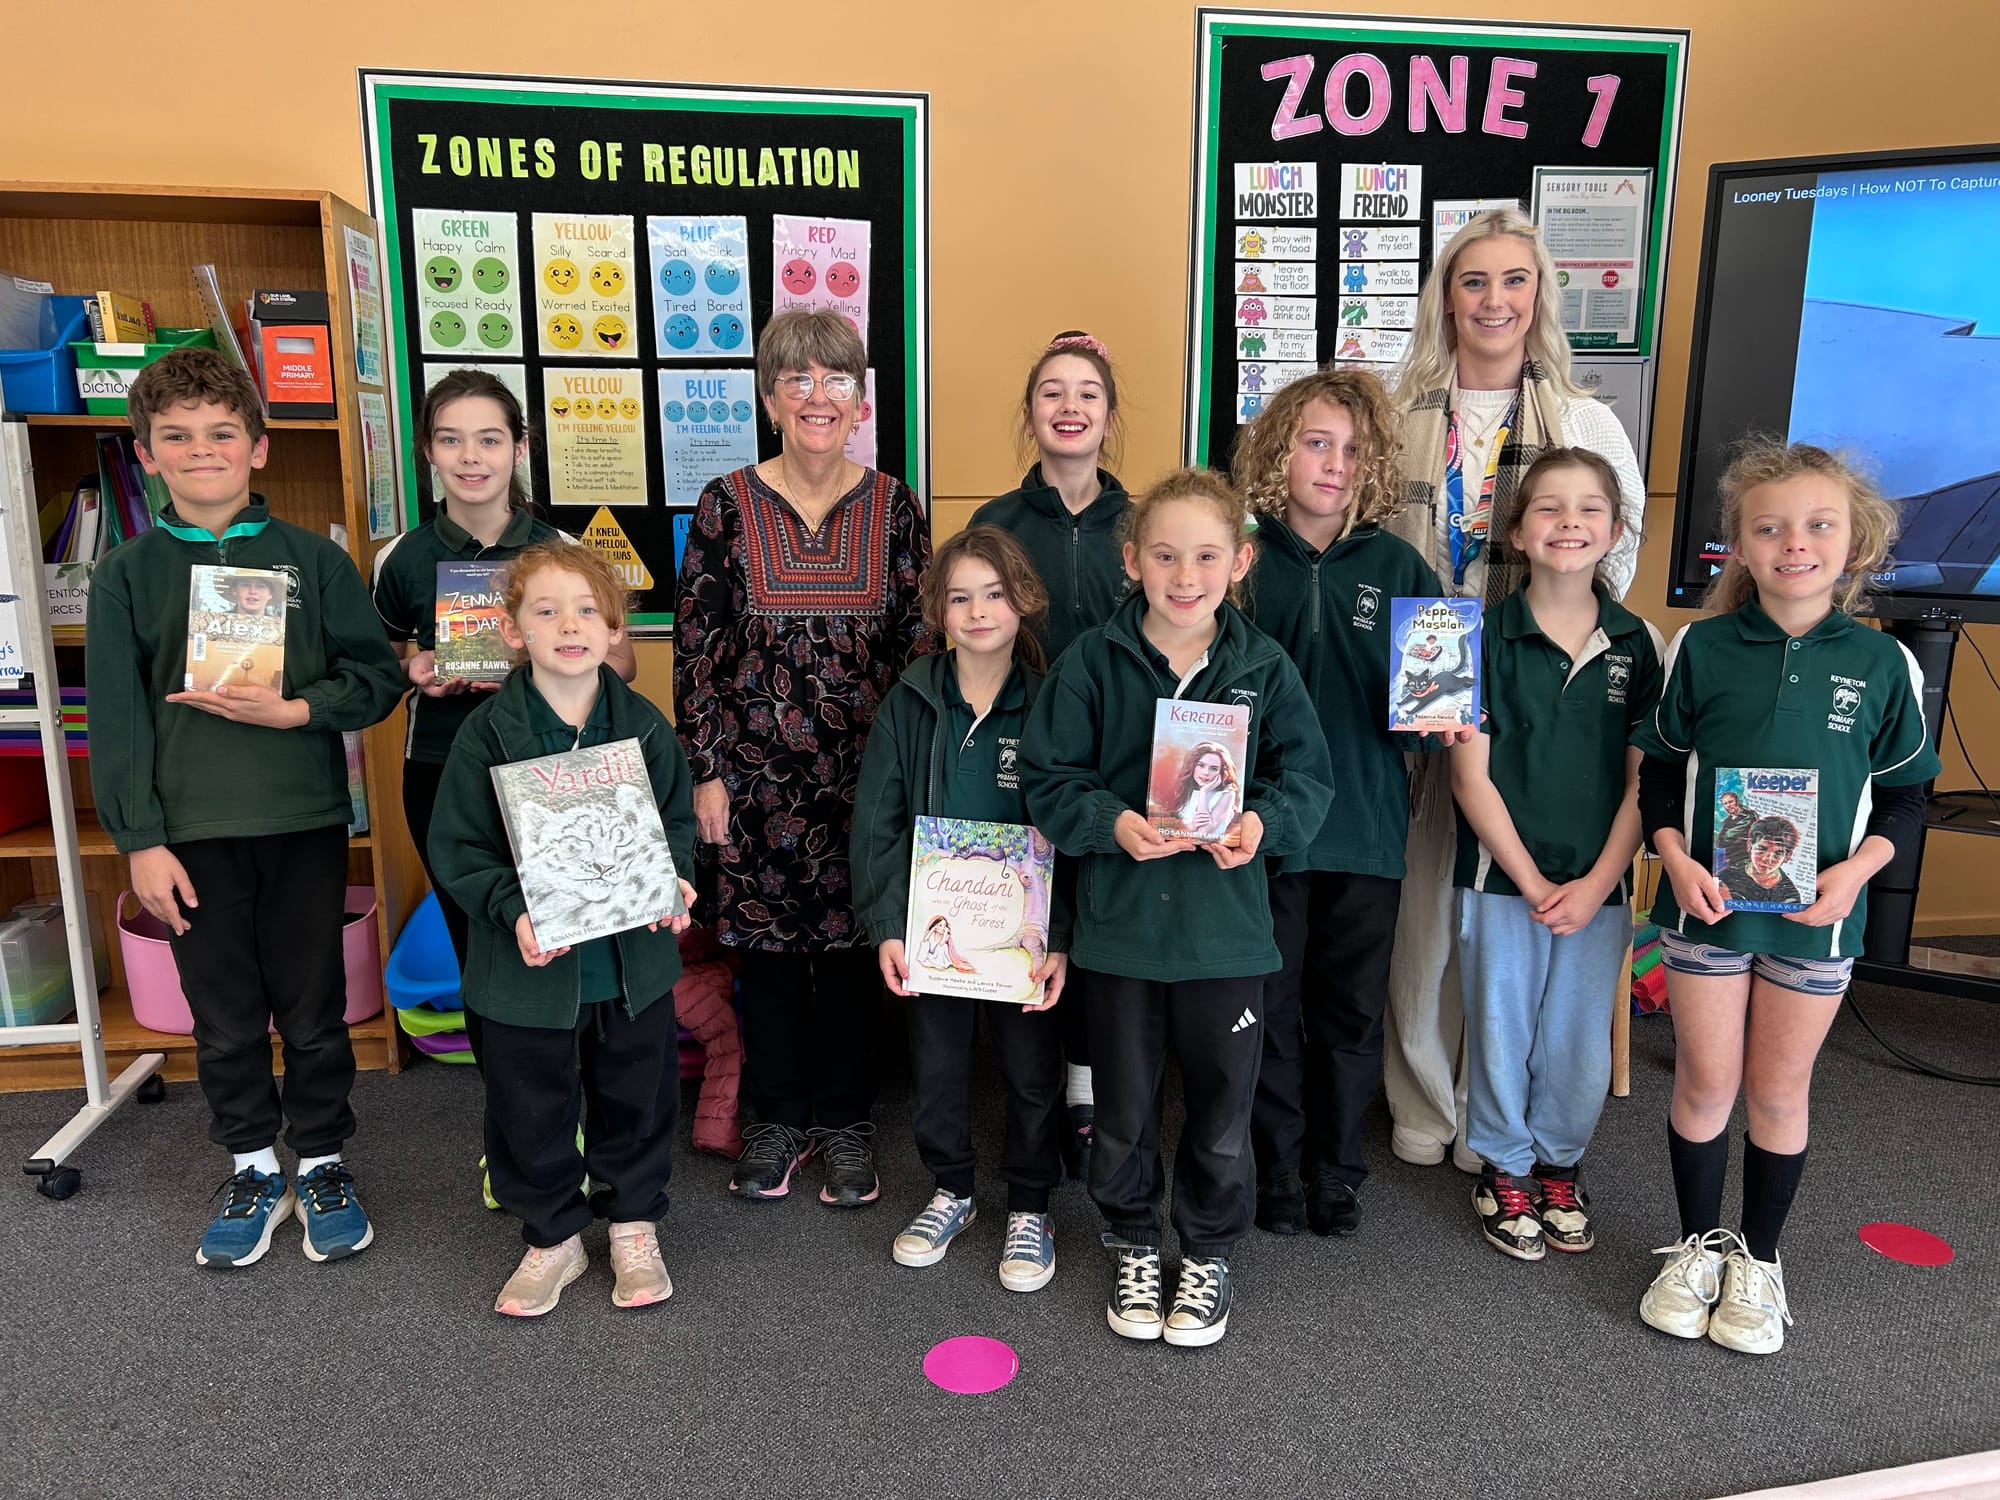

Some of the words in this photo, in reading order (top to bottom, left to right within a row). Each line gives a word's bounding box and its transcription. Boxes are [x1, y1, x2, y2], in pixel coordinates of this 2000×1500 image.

[1260, 53, 1538, 141] ZONE
[1581, 74, 1621, 148] 1
[418, 134, 556, 179] ZONES
[580, 140, 623, 181] OF
[643, 143, 860, 188] REGULATION
[1250, 166, 1302, 191] LUNCH
[1355, 168, 1408, 192] LUNCH
[1546, 182, 1581, 192] SENSORY
[1584, 182, 1608, 192] TOOLS
[1734, 190, 1781, 204] Looney
[1785, 185, 1848, 200] Tuesdays
[1859, 183, 1890, 195] How
[1894, 180, 1926, 193] NOT
[1930, 178, 1946, 191] To
[1239, 192, 1314, 217] MONSTER
[1353, 194, 1408, 218] FRIEND
[1436, 210, 1466, 225] LUNCH
[441, 219, 489, 238] GREEN
[554, 222, 611, 241] YELLOW
[680, 225, 715, 242] BLUE
[808, 225, 836, 243] RED
[1272, 235, 1292, 245] play
[1294, 234, 1311, 243] with
[1381, 234, 1399, 243] stay
[1401, 233, 1409, 242] in
[423, 238, 462, 254] Happy
[475, 240, 505, 253] Calm
[550, 245, 572, 258] Silly
[664, 245, 687, 257] Sad
[709, 245, 733, 257] Sick
[1273, 245, 1288, 254] my
[1289, 243, 1310, 253] food
[1378, 243, 1393, 251] my
[1394, 241, 1412, 250] seat
[782, 246, 817, 259] Angry
[831, 247, 855, 260] Mad
[1278, 266, 1304, 274] leave
[1379, 269, 1398, 277] walk
[1400, 269, 1410, 277] to
[1273, 274, 1295, 282] trash
[1375, 278, 1390, 286] my
[1391, 277, 1414, 285] table
[1273, 281, 1288, 290] the
[1290, 281, 1310, 289] floor
[424, 297, 468, 309] Focused
[475, 298, 512, 313] Ready
[541, 300, 586, 311] Worried
[592, 301, 630, 312] Excited
[664, 300, 697, 312] Tired
[707, 299, 743, 311] Bored
[1273, 304, 1294, 313] pour
[1296, 305, 1310, 313] my
[1397, 300, 1409, 308] an
[1272, 311, 1294, 320] drink
[1295, 312, 1310, 321] out
[1381, 309, 1406, 317] inside
[1381, 318, 1405, 326] voice
[1280, 341, 1290, 349] to
[1292, 343, 1304, 352] my
[1371, 341, 1394, 350] away
[1278, 349, 1307, 358] friends
[82, 382, 133, 394] DICTION
[563, 377, 622, 394] YELLOW
[685, 379, 728, 399] BLUE
[557, 423, 569, 432] I'M
[573, 424, 603, 433] FEELING
[606, 424, 636, 433] YELLOW
[691, 425, 720, 433] FEELING
[723, 424, 743, 433] BLUE
[589, 527, 593, 537] I
[596, 527, 620, 536] KNEW
[595, 539, 628, 549] MELLOW
[1705, 542, 1725, 553] Play
[613, 551, 632, 560] WAS
[47, 588, 88, 599] ENTION
[1417, 604, 1459, 621] Pepper
[206, 619, 264, 638] Alex
[1412, 620, 1465, 630] Masalah
[445, 661, 481, 670] ROSANNE
[482, 660, 510, 670] HAWKE
[1830, 674, 1866, 688] KEYNETON
[1828, 713, 1856, 726] PRIMARY
[1827, 722, 1851, 734] SCHOOL
[998, 737, 1020, 746] KEYNET
[1747, 772, 1811, 793] keeper
[1158, 828, 1198, 838] ROSANNE
[926, 869, 1014, 898] Chandani
[1727, 900, 1765, 909] OSANNE
[971, 914, 1006, 929] Forest
